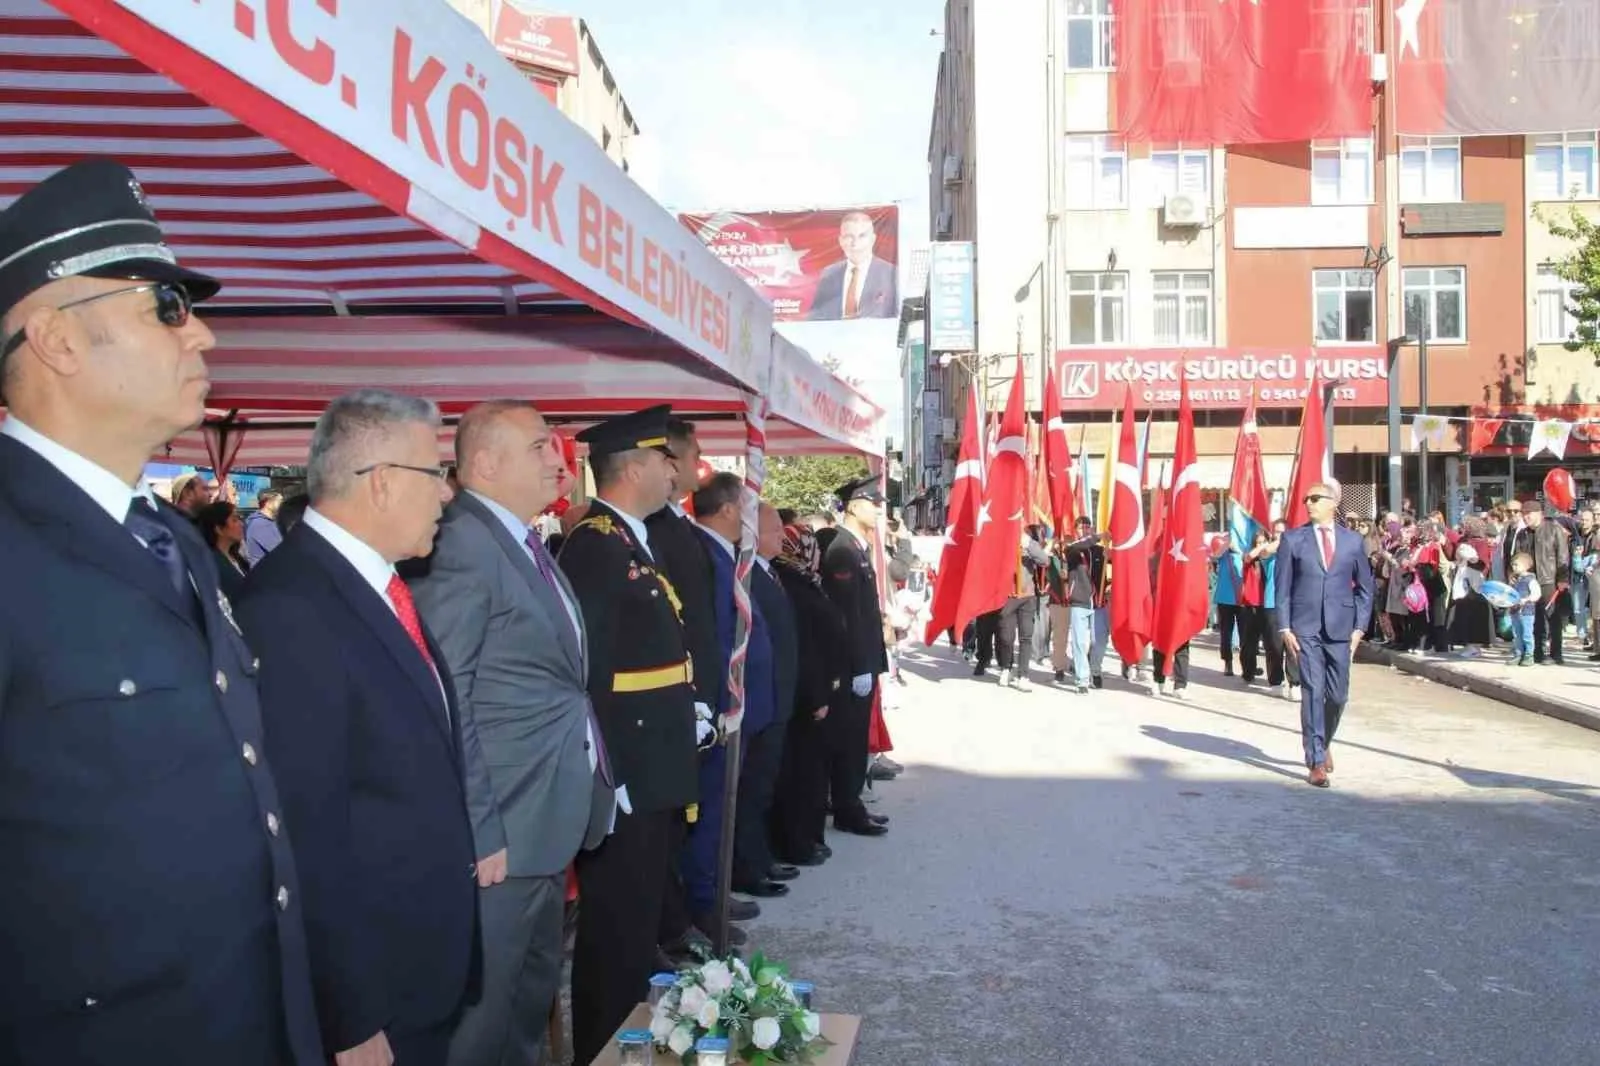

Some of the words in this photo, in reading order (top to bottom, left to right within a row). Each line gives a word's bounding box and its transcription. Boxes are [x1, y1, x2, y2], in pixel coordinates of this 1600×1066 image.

[195, 0, 357, 109] .C.
[391, 25, 566, 248] KÖŞK
[578, 183, 733, 354] BELEDİYESİ
[1104, 356, 1177, 384] KÖŞK
[1184, 355, 1297, 381] SÜRÜCÜ
